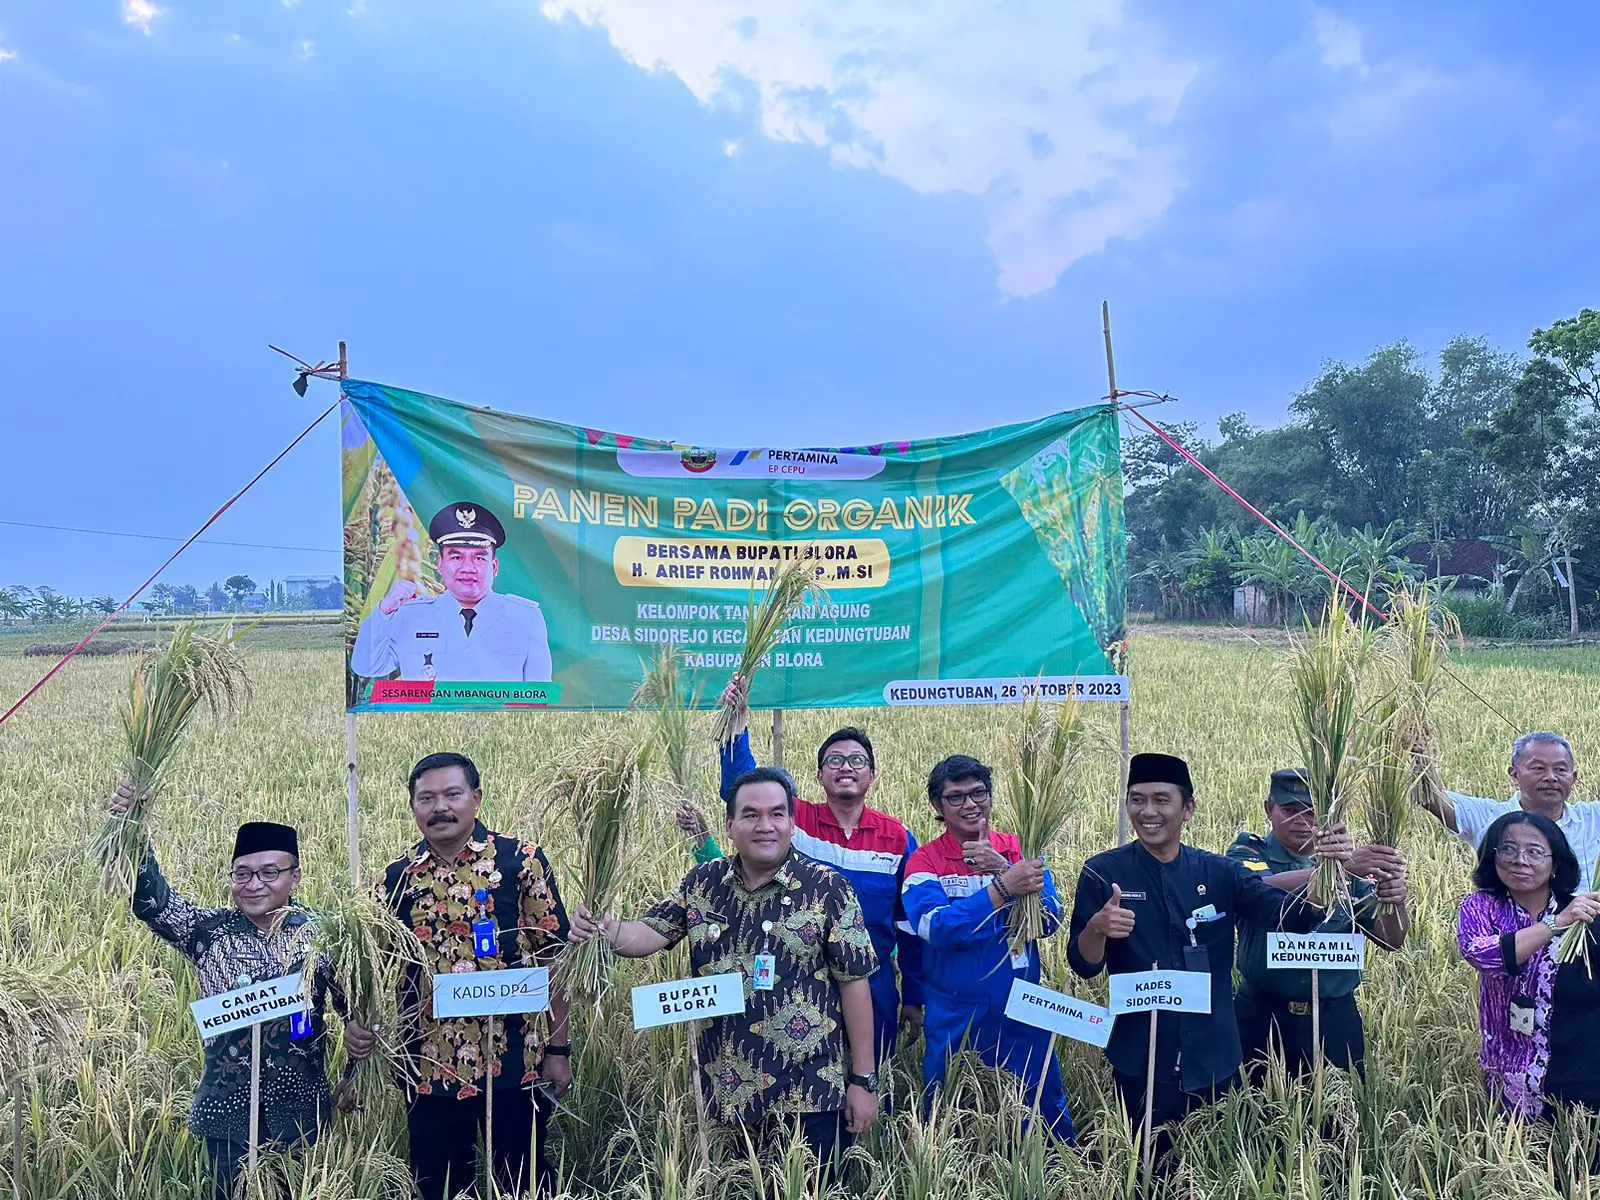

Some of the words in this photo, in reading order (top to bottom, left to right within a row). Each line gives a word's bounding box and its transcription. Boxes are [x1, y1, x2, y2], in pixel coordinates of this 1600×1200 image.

[768, 449, 838, 464] PERTAMINA
[768, 465, 779, 473] EP
[781, 466, 806, 474] CEPU
[513, 484, 658, 528] PANEN
[673, 497, 768, 531] PADI
[783, 494, 977, 531] ORGANIK
[646, 543, 732, 560] BERSAMA
[736, 545, 798, 560] BUPATI
[803, 545, 858, 560] BLORA
[632, 562, 648, 577] H.
[656, 564, 705, 579] ARIEF
[637, 603, 720, 620] KELOMPOK
[819, 603, 870, 619] AGUNG
[591, 625, 631, 642] DESA
[634, 626, 708, 644] SIDOREJO
[805, 625, 911, 644] KEDUNGTUBAN
[684, 652, 771, 668] KABUPAN
[776, 652, 823, 668] BLORA
[381, 688, 450, 699] SESARENGAN
[454, 689, 510, 699] MBANGUN
[512, 690, 547, 699] BLORA
[890, 684, 998, 701] KEDUNGTUBAN,
[1001, 685, 1017, 698] 26
[1088, 682, 1122, 696] 2023
[1278, 940, 1354, 951] DANRAMIL
[1271, 952, 1360, 963] KEDUNGTUBAN
[452, 984, 496, 1000] KADIS
[500, 983, 528, 998] DP4
[658, 984, 718, 1002] BUPATI
[1135, 980, 1172, 992] KADES
[222, 986, 278, 1009] CAMAT
[662, 998, 717, 1014] BLORA
[1126, 996, 1183, 1008] SIDOREJO
[202, 992, 305, 1030] KEDUNGTUBAN
[1022, 992, 1084, 1020] PERTAMINA
[1088, 1014, 1104, 1025] EP
